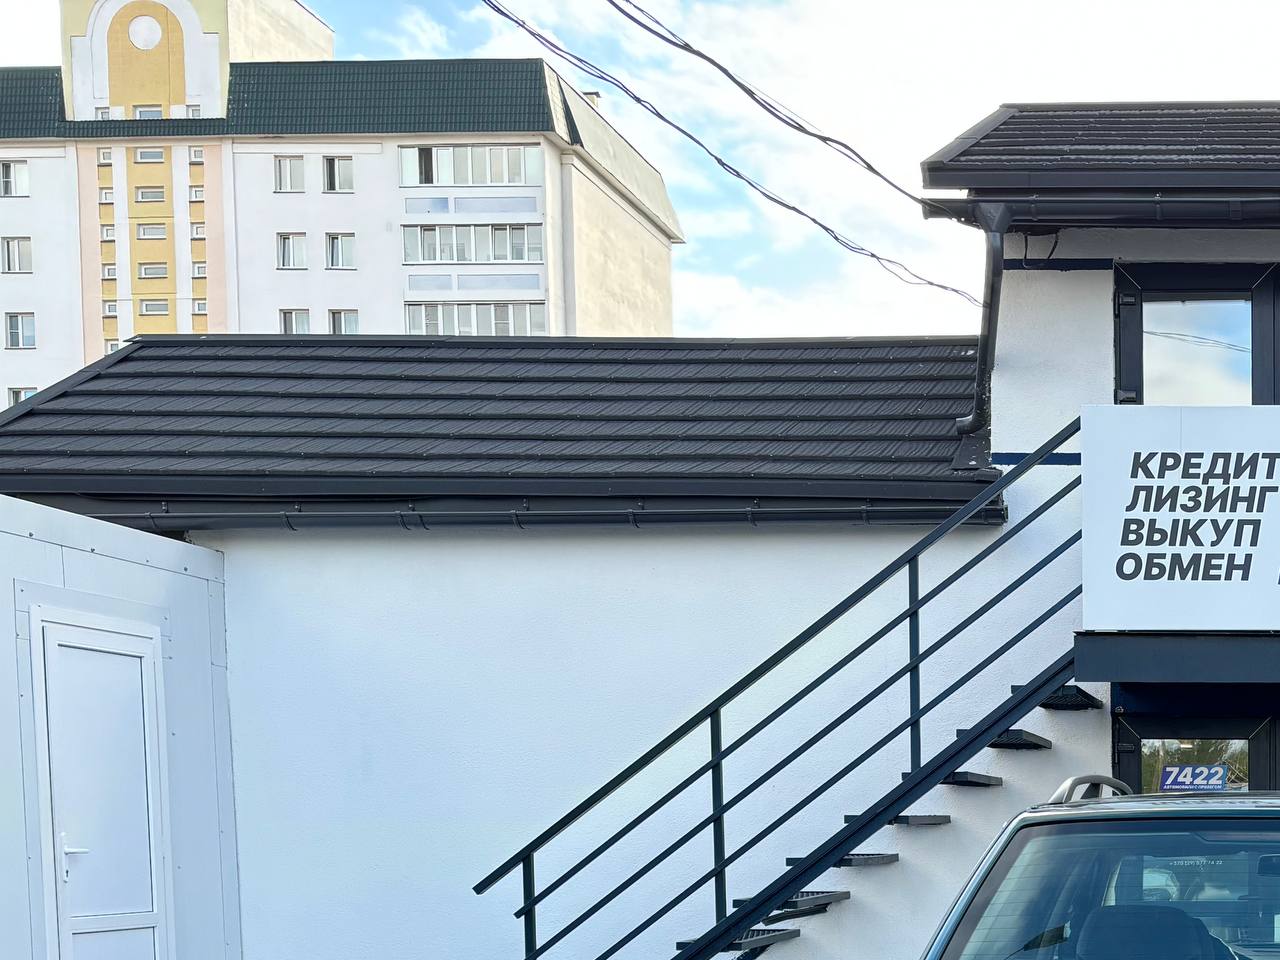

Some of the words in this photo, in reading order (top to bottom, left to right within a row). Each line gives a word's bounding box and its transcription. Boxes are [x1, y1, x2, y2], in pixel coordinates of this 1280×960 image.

[1125, 485, 1279, 513] ЛИЗИНГ
[1120, 518, 1262, 547] ВЫКУП
[1115, 552, 1253, 581] ОБМЕН
[1165, 766, 1224, 785] 7422
